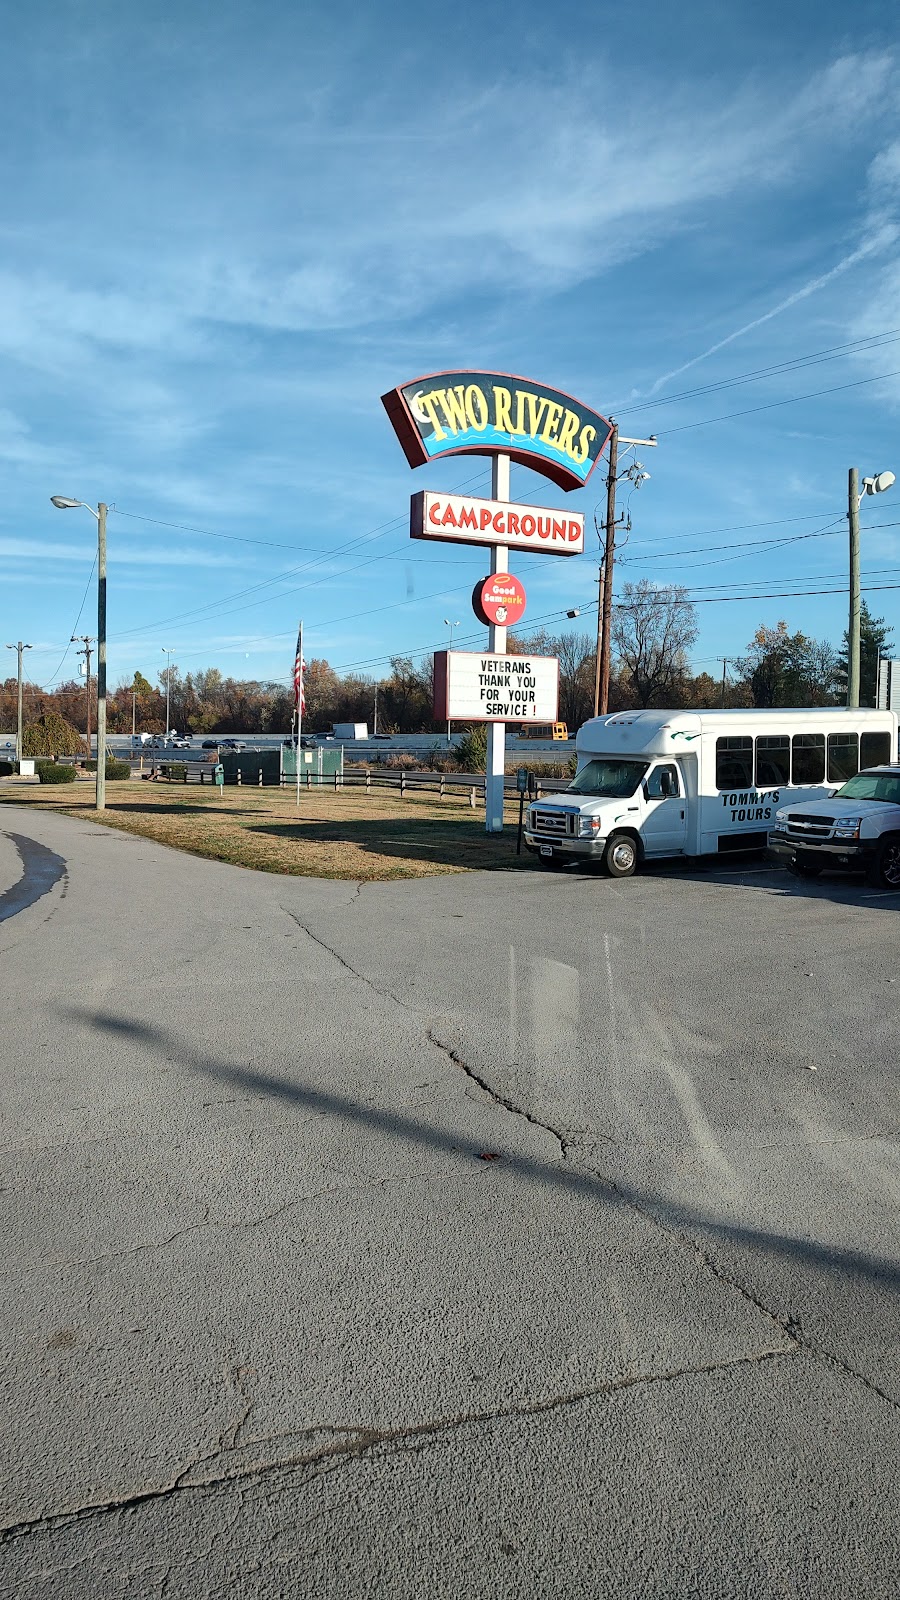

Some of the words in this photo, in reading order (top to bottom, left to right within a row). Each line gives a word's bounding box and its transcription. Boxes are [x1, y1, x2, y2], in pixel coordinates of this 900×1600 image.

[418, 384, 488, 442] TWO
[492, 385, 596, 464] RIVERS
[428, 501, 582, 542] CAMPGROUND
[492, 585, 515, 595] Good
[481, 660, 531, 673] VETERANS
[479, 674, 510, 686] THANK
[517, 676, 536, 688] YOU
[480, 689, 499, 700] FOR
[508, 690, 535, 702] YOUR
[486, 703, 527, 716] SERVICE
[721, 790, 780, 808] TOMMY'S
[730, 807, 772, 822] TOURS
